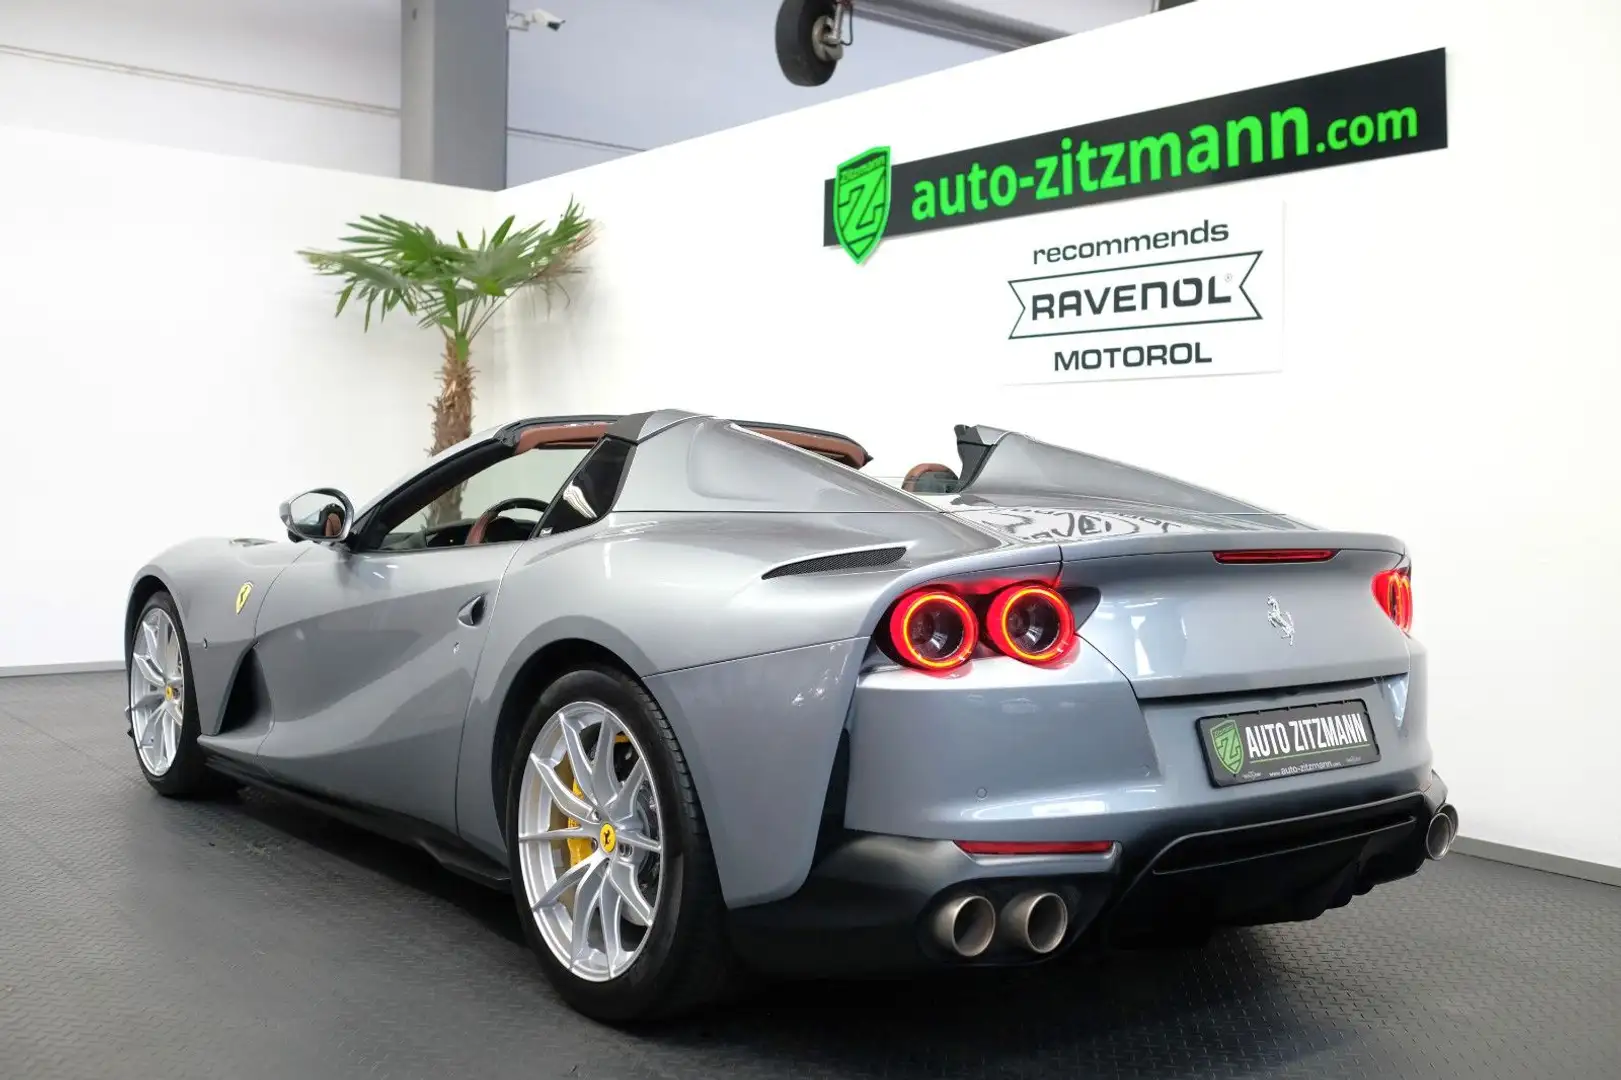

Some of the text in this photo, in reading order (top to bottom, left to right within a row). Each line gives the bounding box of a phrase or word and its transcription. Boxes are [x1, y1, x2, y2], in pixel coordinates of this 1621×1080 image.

[911, 106, 1418, 221] auto-zitzmann.com
[1033, 219, 1229, 265] recommends
[1031, 275, 1232, 321] RAVENOL
[1053, 342, 1213, 372] MOTOROL
[1245, 713, 1368, 759] AUTO ZITZMANN
